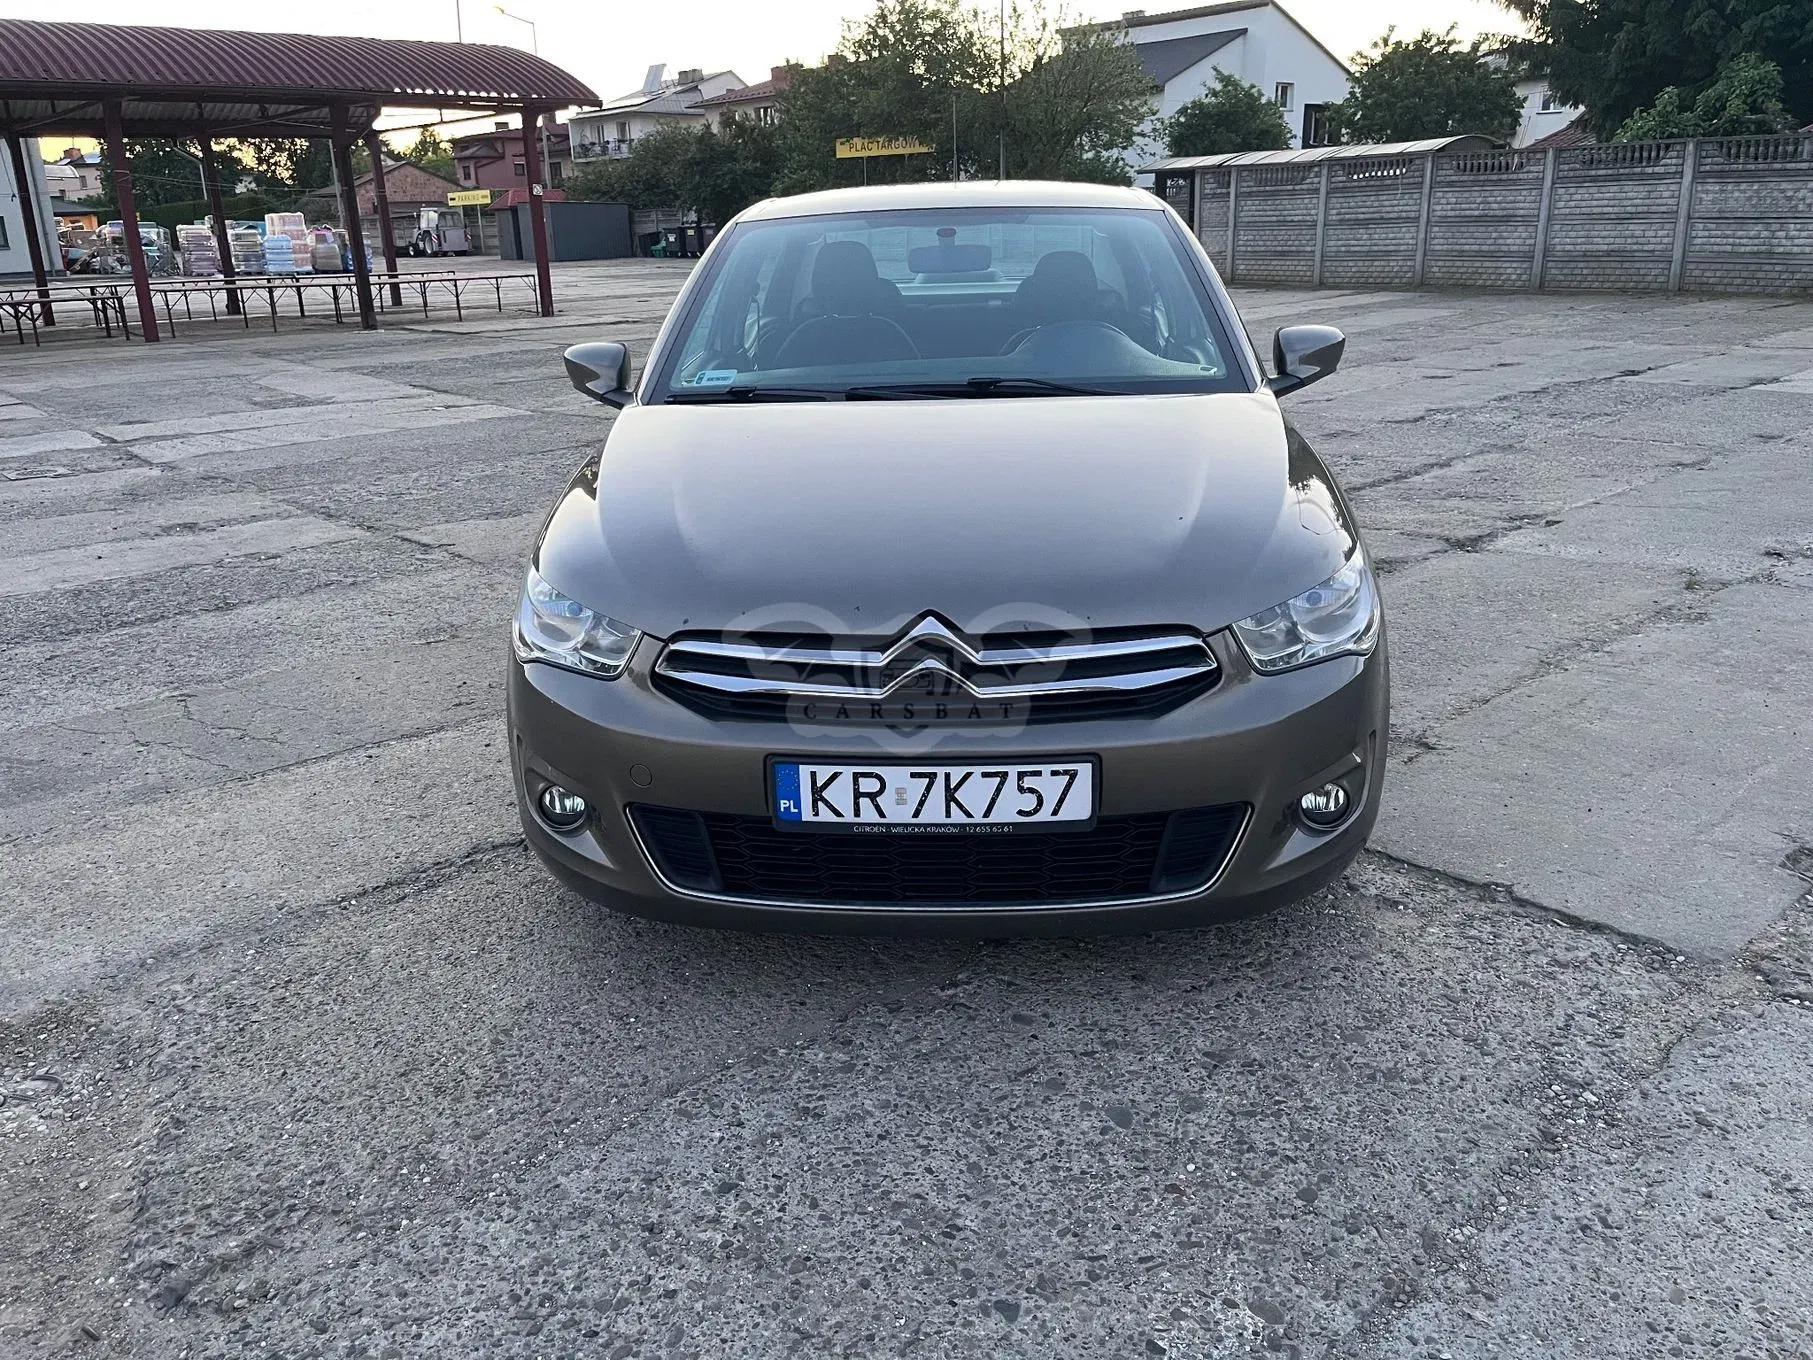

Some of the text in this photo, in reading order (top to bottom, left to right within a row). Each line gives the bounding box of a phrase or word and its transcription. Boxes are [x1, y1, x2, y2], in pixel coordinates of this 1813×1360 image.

[849, 142, 873, 152] PLAC
[809, 769, 1079, 819] KR 7K757
[780, 800, 799, 813] PL
[890, 825, 926, 833] WIELICKA
[926, 824, 960, 833] KRAKÓW
[966, 825, 975, 833] 12
[976, 825, 991, 833] 655
